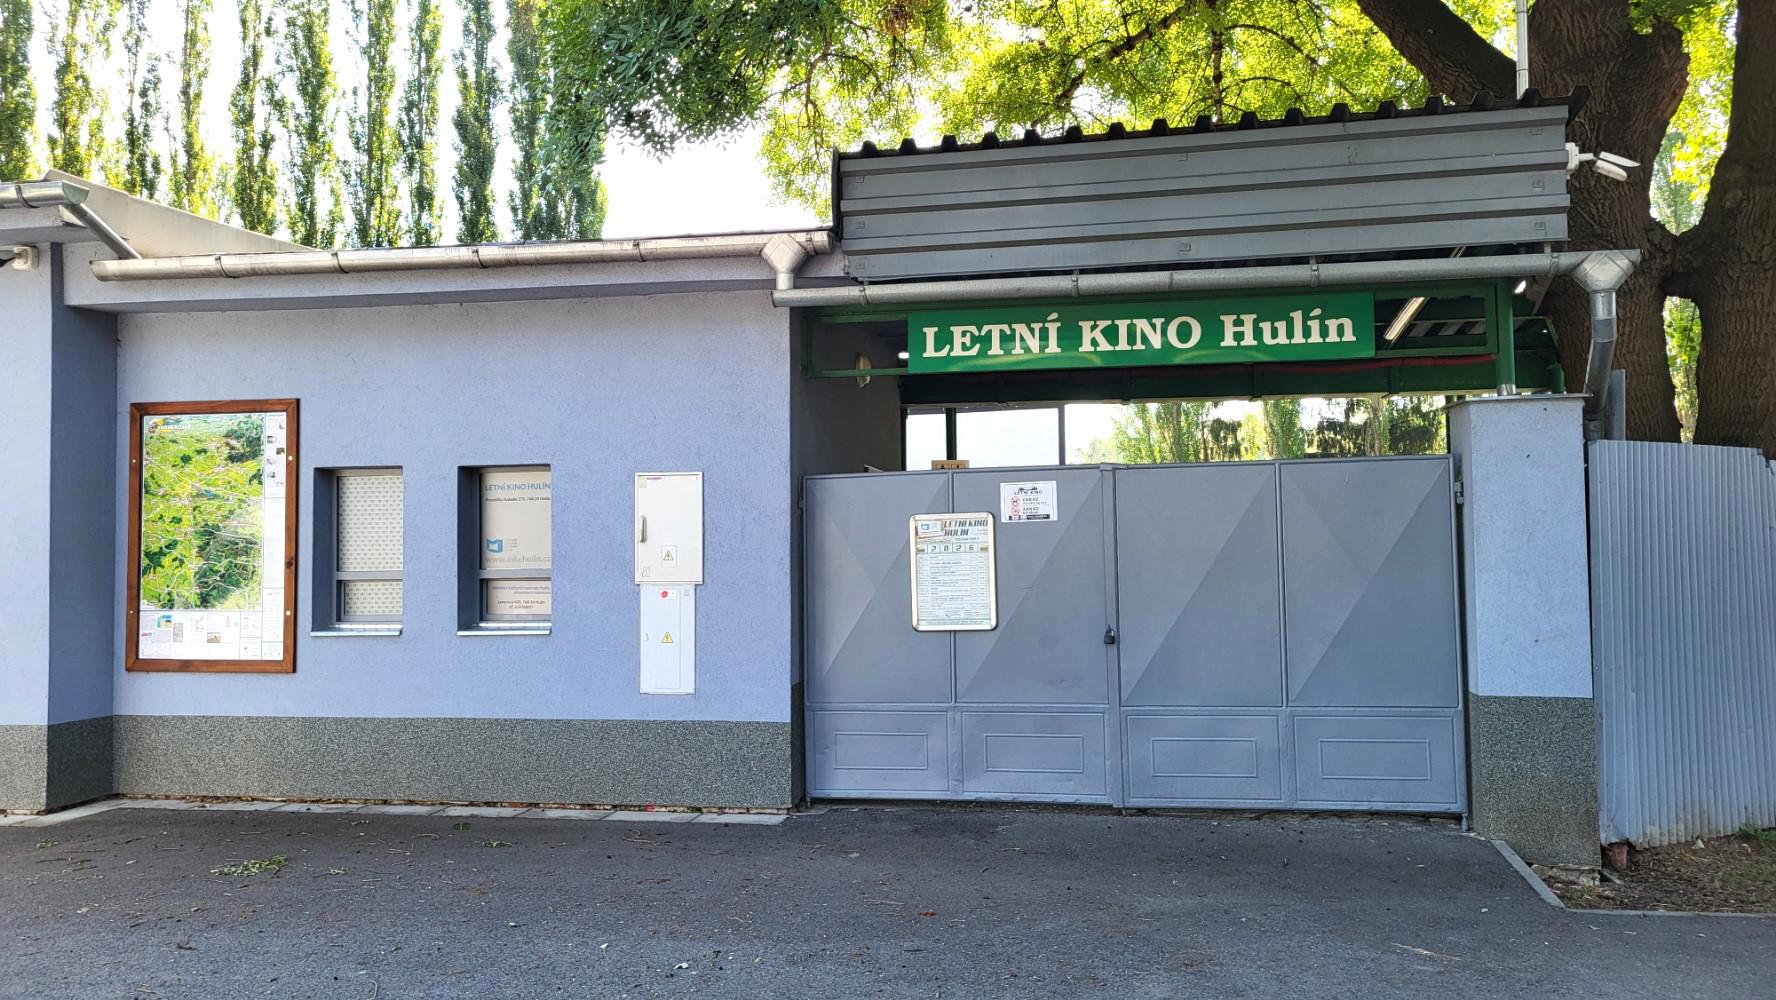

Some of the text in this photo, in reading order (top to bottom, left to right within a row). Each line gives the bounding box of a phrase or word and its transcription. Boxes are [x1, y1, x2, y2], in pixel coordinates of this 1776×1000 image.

[922, 308, 1357, 358] LETNÍ KINO Hulín
[506, 483, 527, 491] KINO
